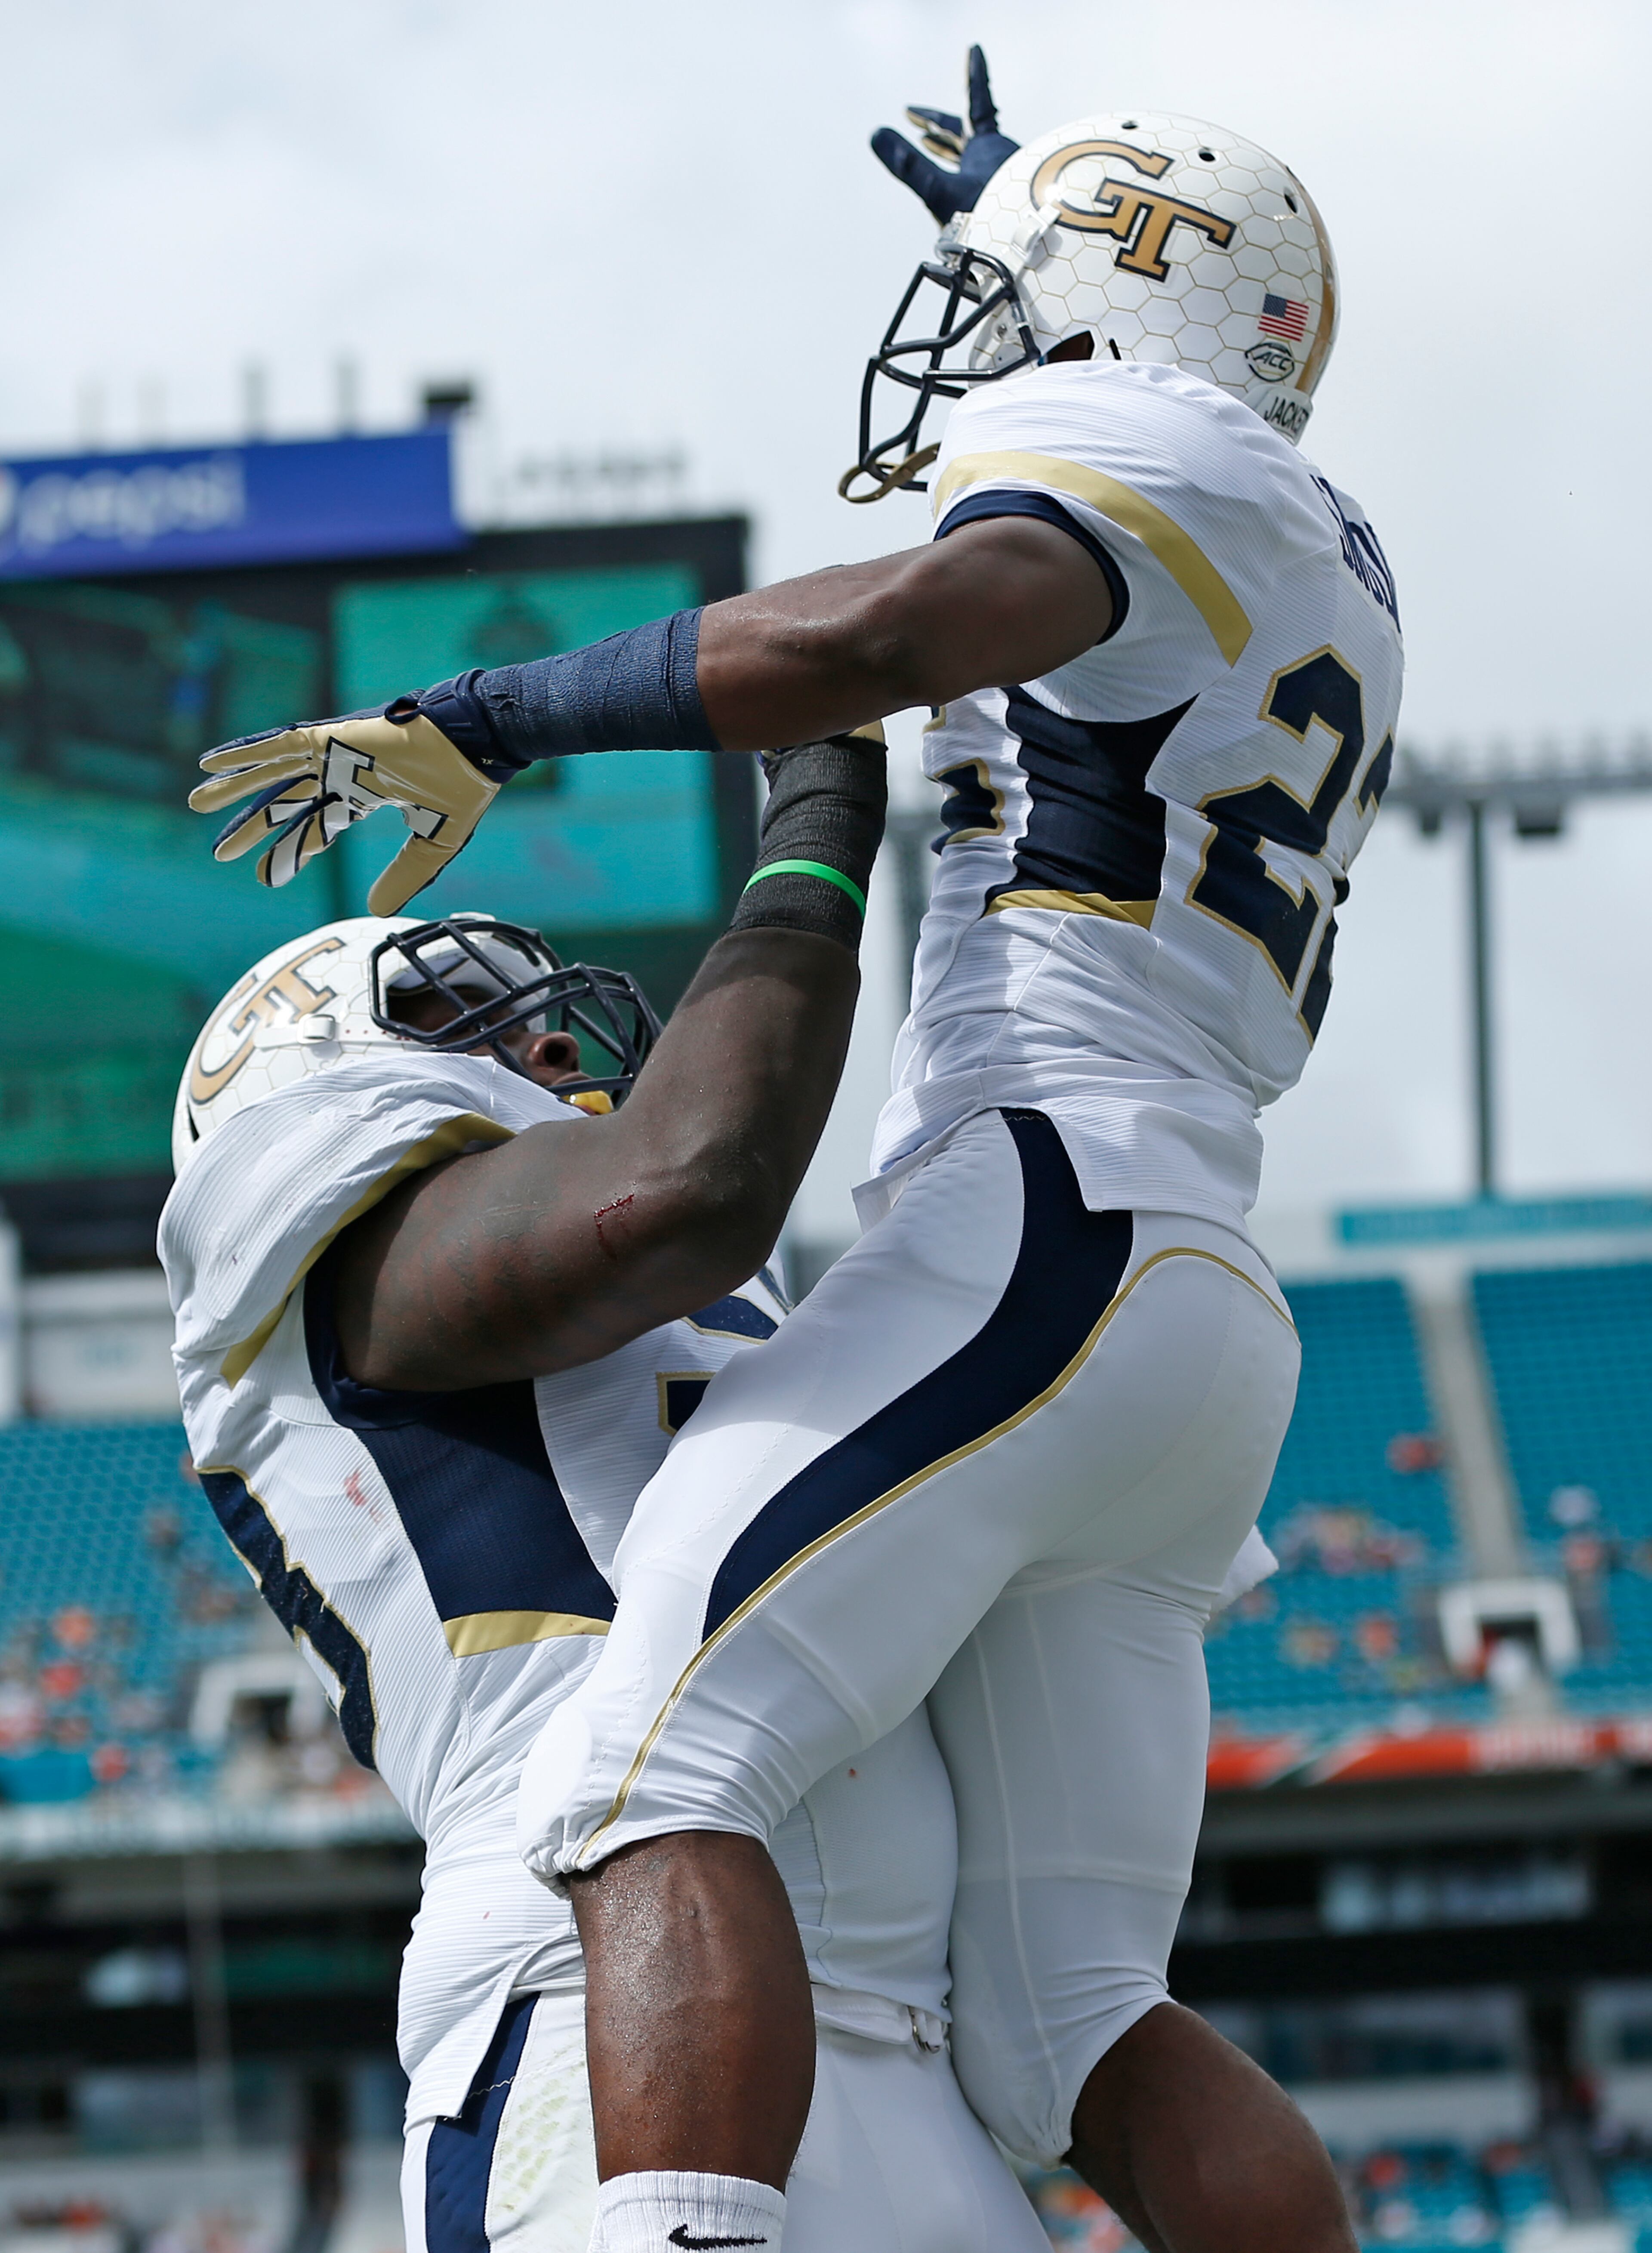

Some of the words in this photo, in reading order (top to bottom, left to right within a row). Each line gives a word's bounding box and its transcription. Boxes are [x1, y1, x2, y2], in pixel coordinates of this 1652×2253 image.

[1030, 140, 1237, 283] GT
[1253, 351, 1292, 371] ACC
[188, 937, 346, 1105] GT
